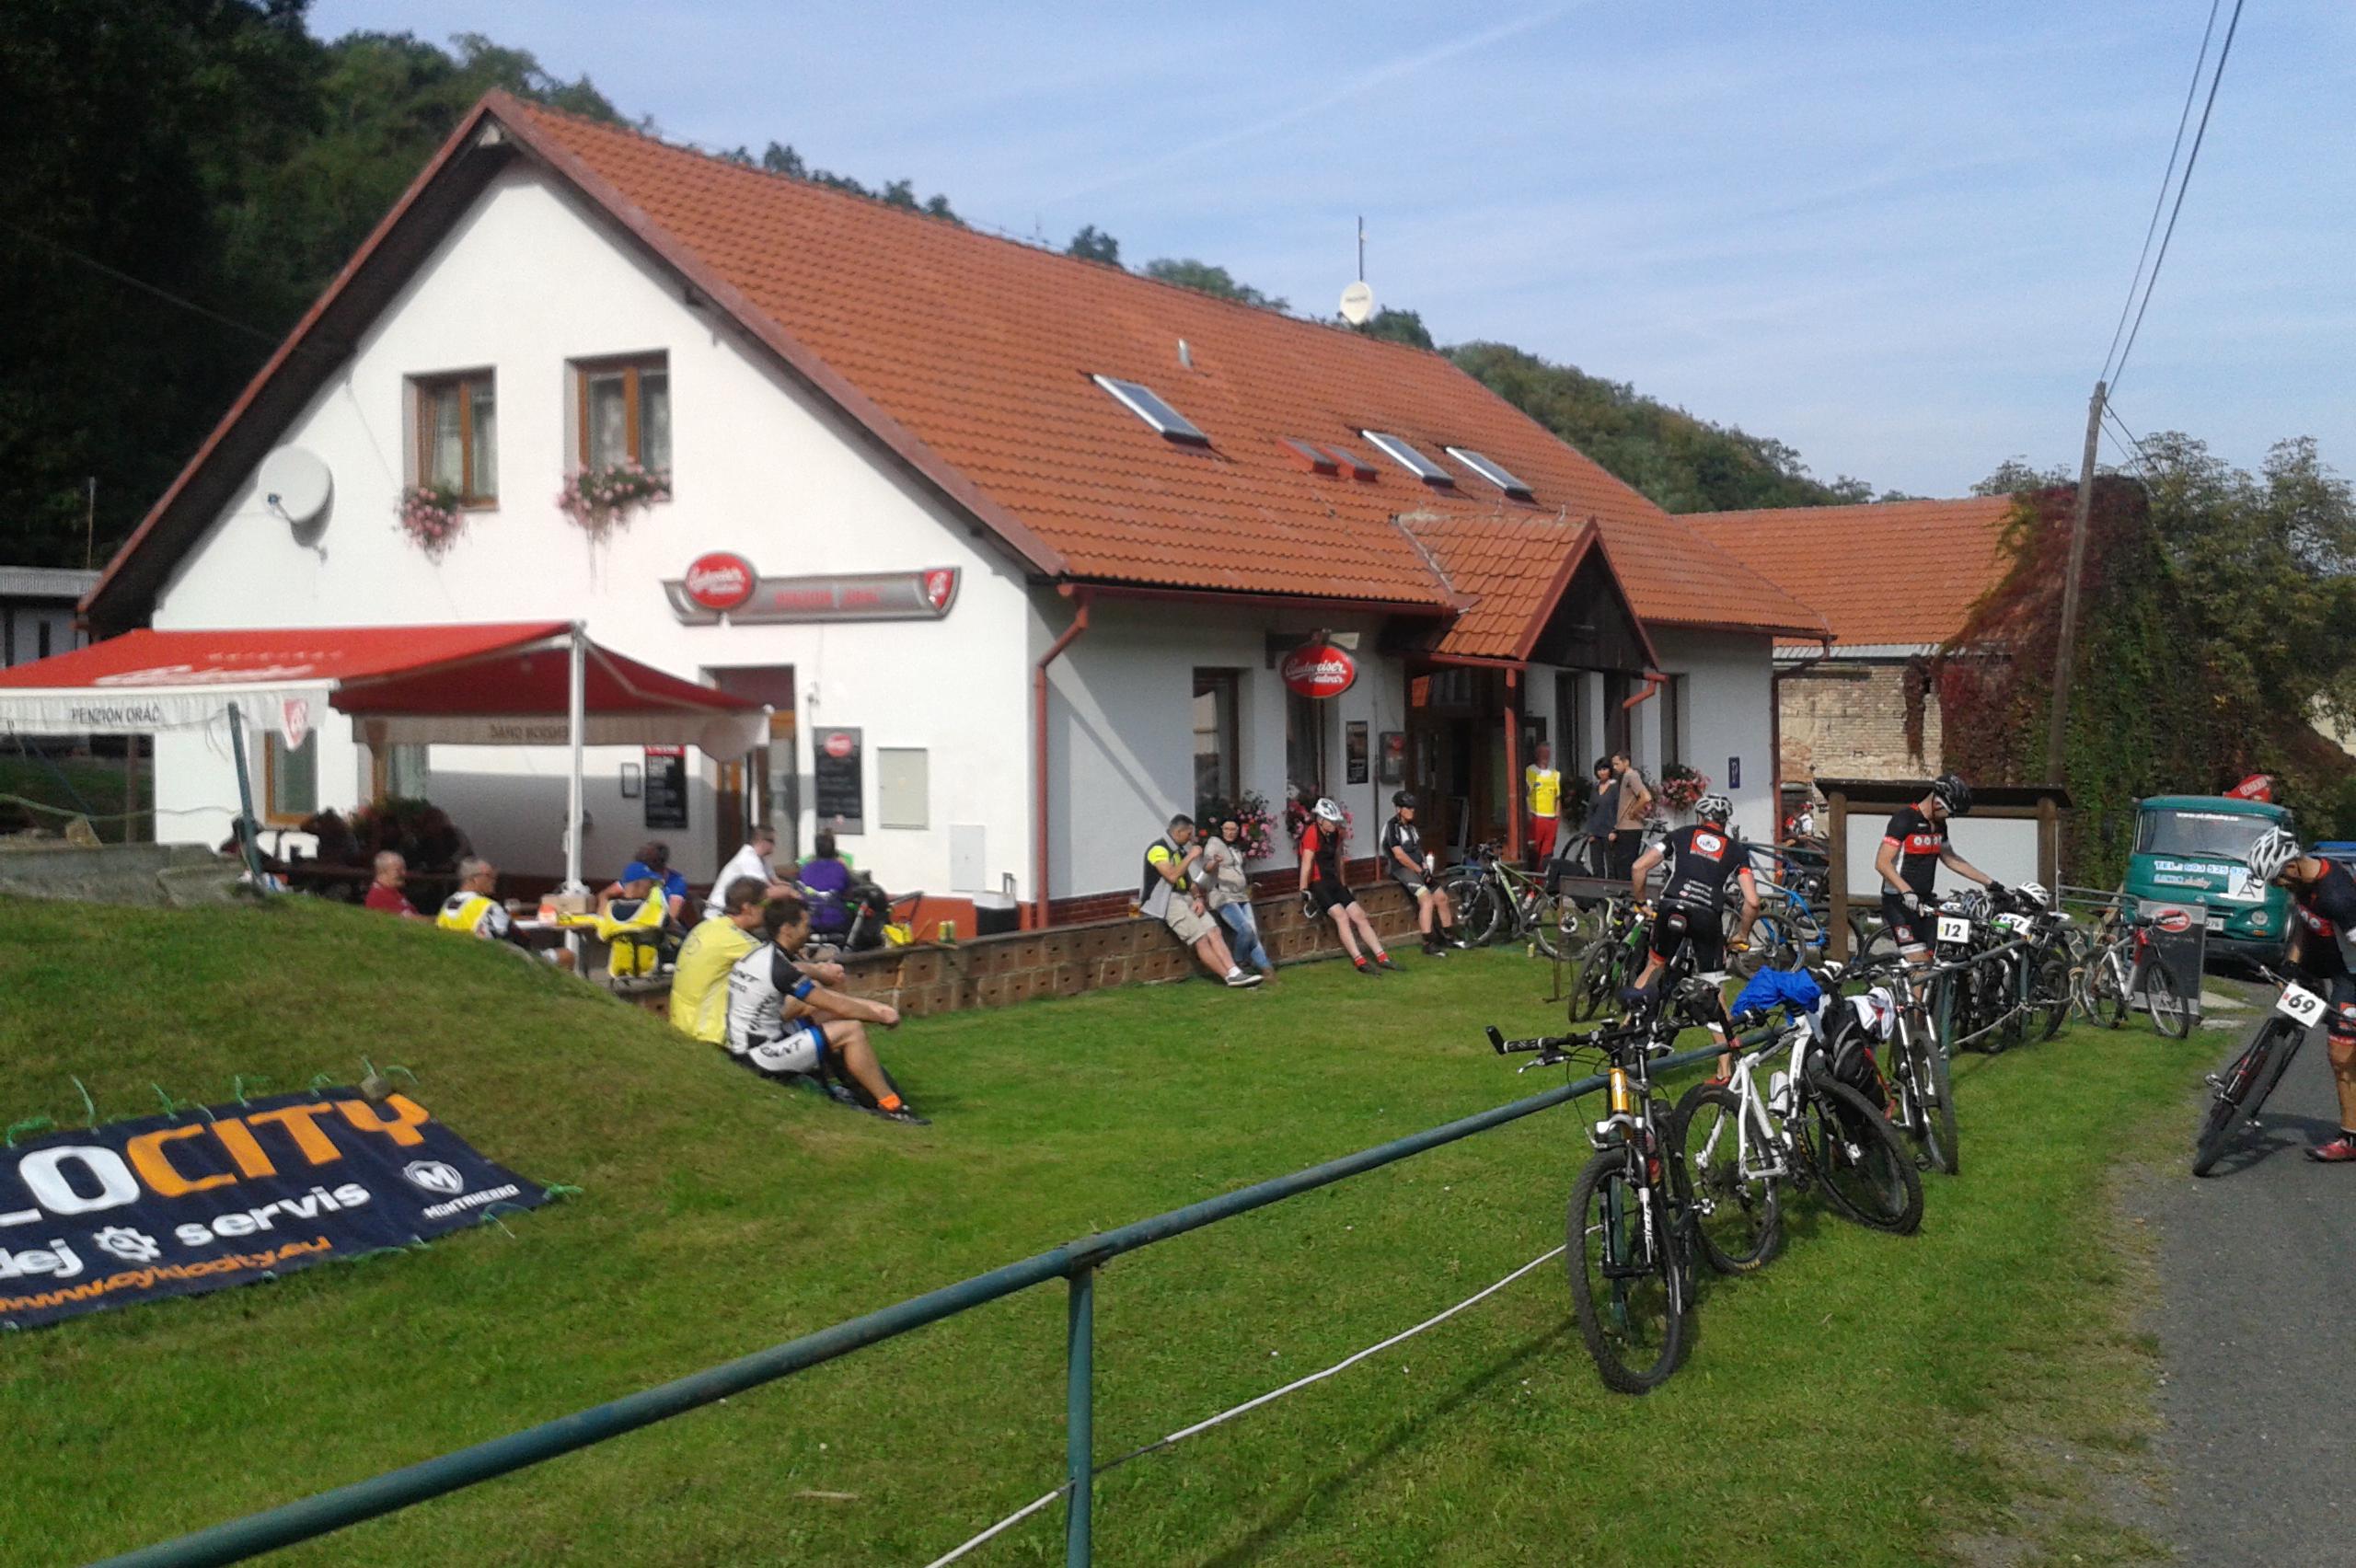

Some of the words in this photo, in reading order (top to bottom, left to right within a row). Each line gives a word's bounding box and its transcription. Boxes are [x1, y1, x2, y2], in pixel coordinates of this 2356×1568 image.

[1945, 923, 1961, 938] 12
[2288, 993, 2316, 1015] 69
[0, 1093, 431, 1228] OCITY
[174, 1182, 372, 1246] servis
